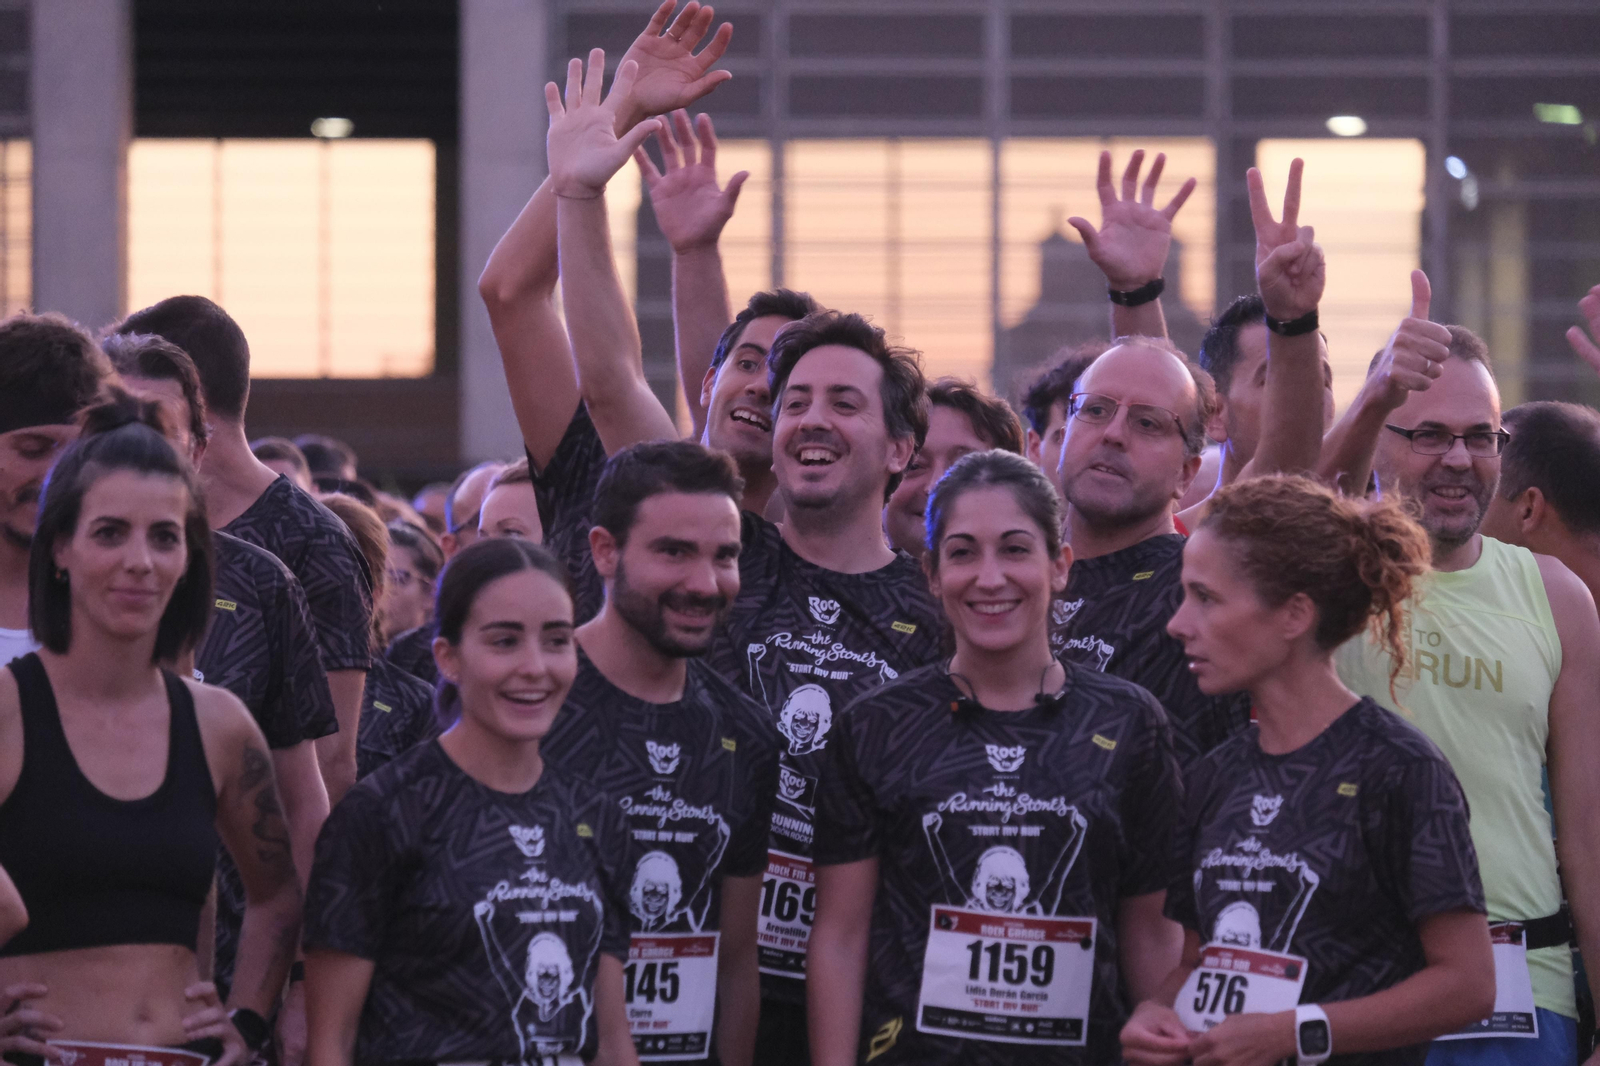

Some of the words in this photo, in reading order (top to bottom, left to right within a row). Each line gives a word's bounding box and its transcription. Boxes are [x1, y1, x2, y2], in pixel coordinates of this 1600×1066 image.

[802, 630, 831, 645] the
[1415, 629, 1441, 647] TO
[766, 632, 828, 665] Running
[827, 643, 881, 668] Stones
[1414, 649, 1503, 693] RUN
[645, 740, 681, 760] Rock
[985, 744, 1027, 760] Rock
[779, 769, 807, 788] Rock
[644, 784, 673, 802] the
[983, 782, 1017, 798] the
[938, 792, 1011, 823] Running
[1012, 794, 1071, 817] Stones
[1236, 836, 1262, 852] the
[966, 940, 1055, 987] 1159
[624, 961, 680, 1004] 145
[1193, 972, 1249, 1014] 576
